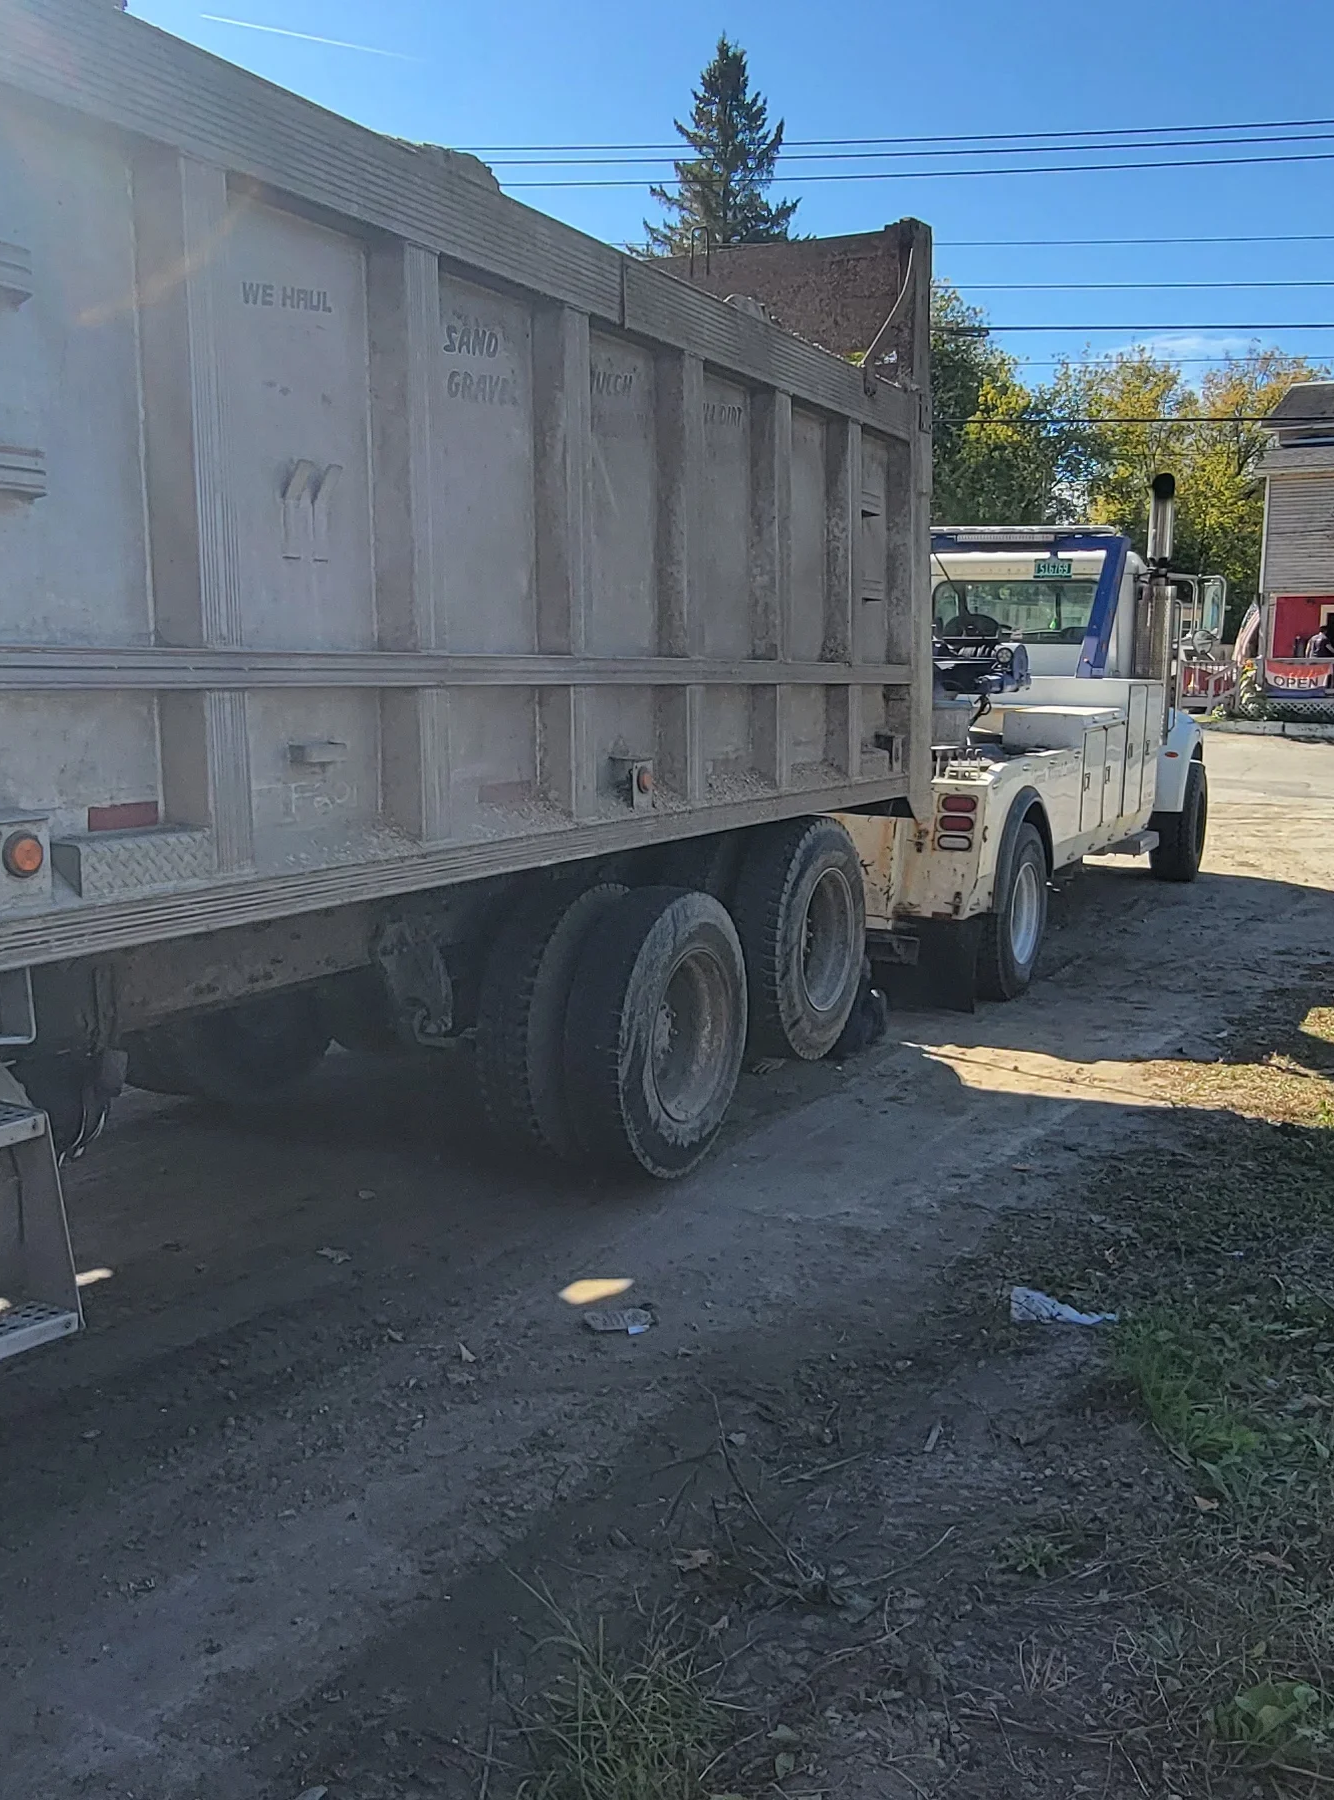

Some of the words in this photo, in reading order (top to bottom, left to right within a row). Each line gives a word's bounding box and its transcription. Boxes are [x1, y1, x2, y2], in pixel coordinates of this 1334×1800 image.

[241, 281, 274, 306] WE
[281, 286, 332, 313] HAUL
[443, 324, 499, 358] SAND
[590, 370, 633, 396] ULCH
[720, 404, 743, 427] DIRT
[1274, 675, 1318, 688] OPEN
